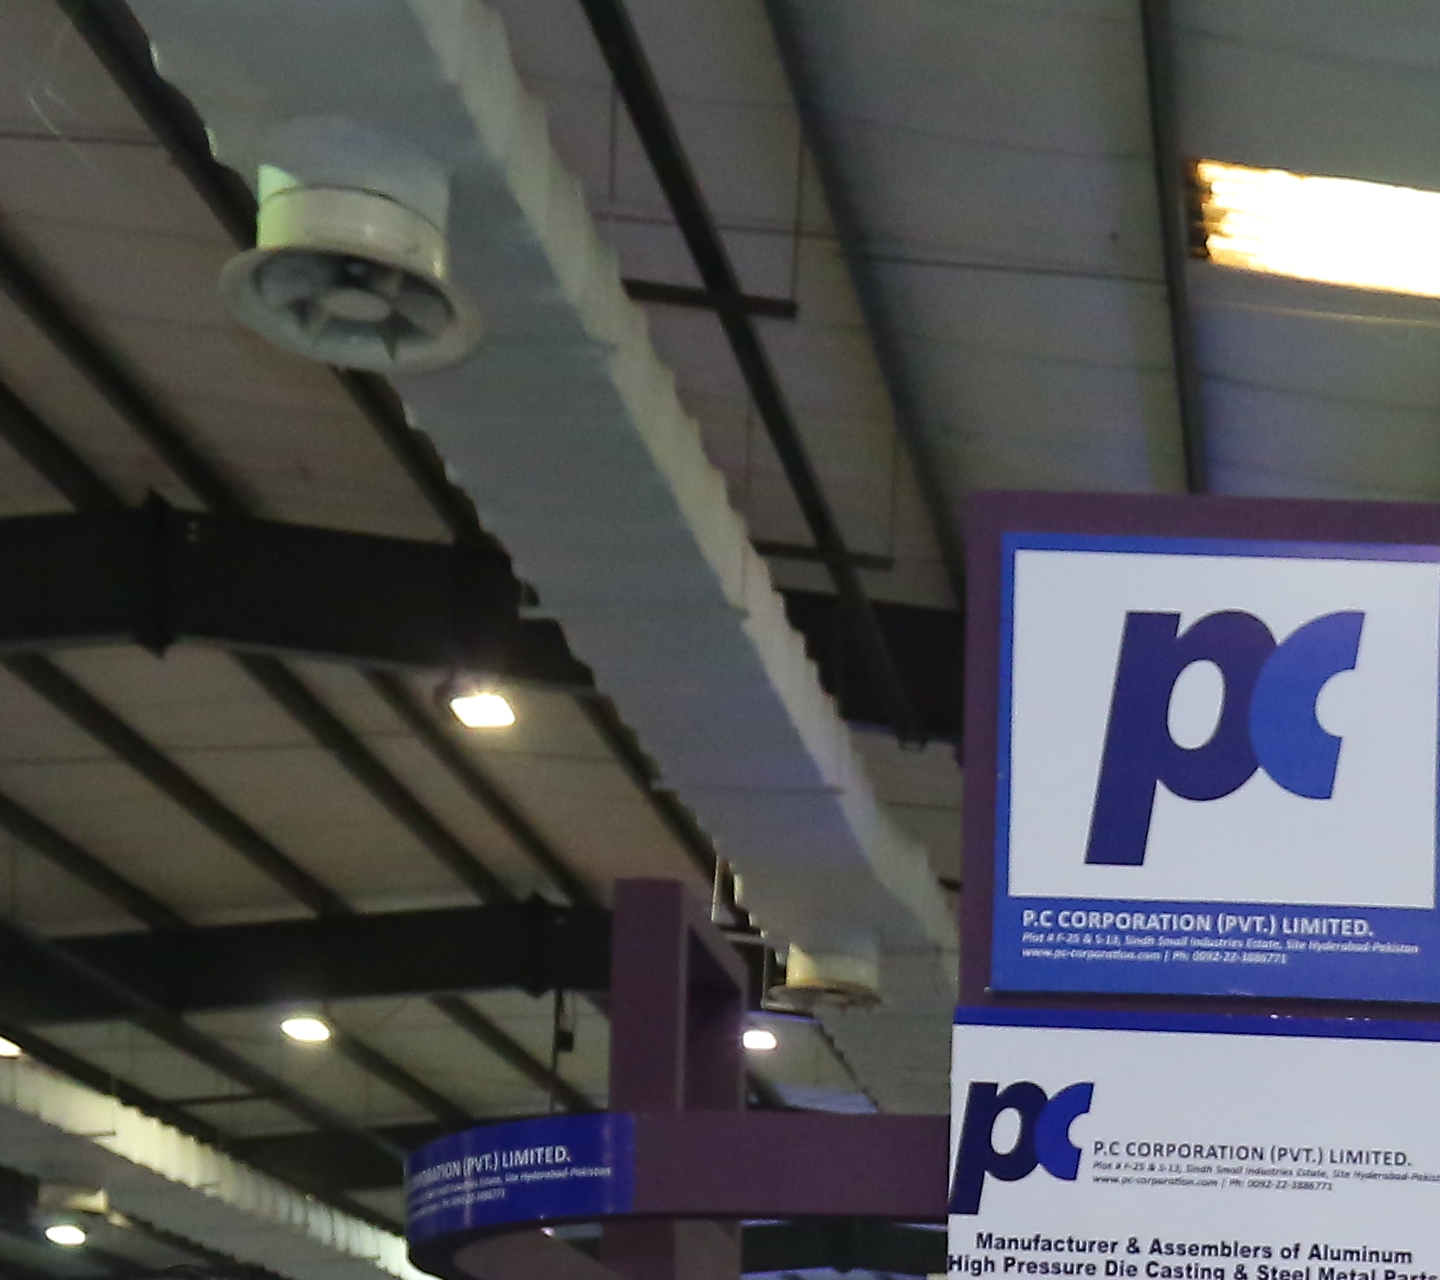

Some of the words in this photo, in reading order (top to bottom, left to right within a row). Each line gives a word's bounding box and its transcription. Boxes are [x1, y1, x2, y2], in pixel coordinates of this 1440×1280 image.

[1084, 609, 1366, 866] pc
[1022, 910, 1053, 927] P.C
[1058, 910, 1211, 931] CORPORATION
[1217, 912, 1277, 935] (PVT.)
[1282, 917, 1375, 937] LIMITED.
[502, 1146, 571, 1168] LIMITED.
[949, 1080, 1094, 1214] pc
[1093, 1141, 1119, 1156] P.C
[1126, 1142, 1264, 1161] CORPORATION
[1270, 1144, 1324, 1166] (PVT.)
[1329, 1149, 1412, 1167] LIMITED.
[1216, 1165, 1243, 1175] Small
[976, 1232, 1118, 1253] Manufacturer
[1126, 1237, 1140, 1254] &
[1148, 1238, 1272, 1259] Assemblers
[1280, 1242, 1301, 1259] of
[1308, 1244, 1412, 1263] Aluminum
[948, 1255, 995, 1276] High
[1003, 1257, 1096, 1276] Pressure
[1105, 1259, 1138, 1277] Die
[1233, 1264, 1248, 1280] &
